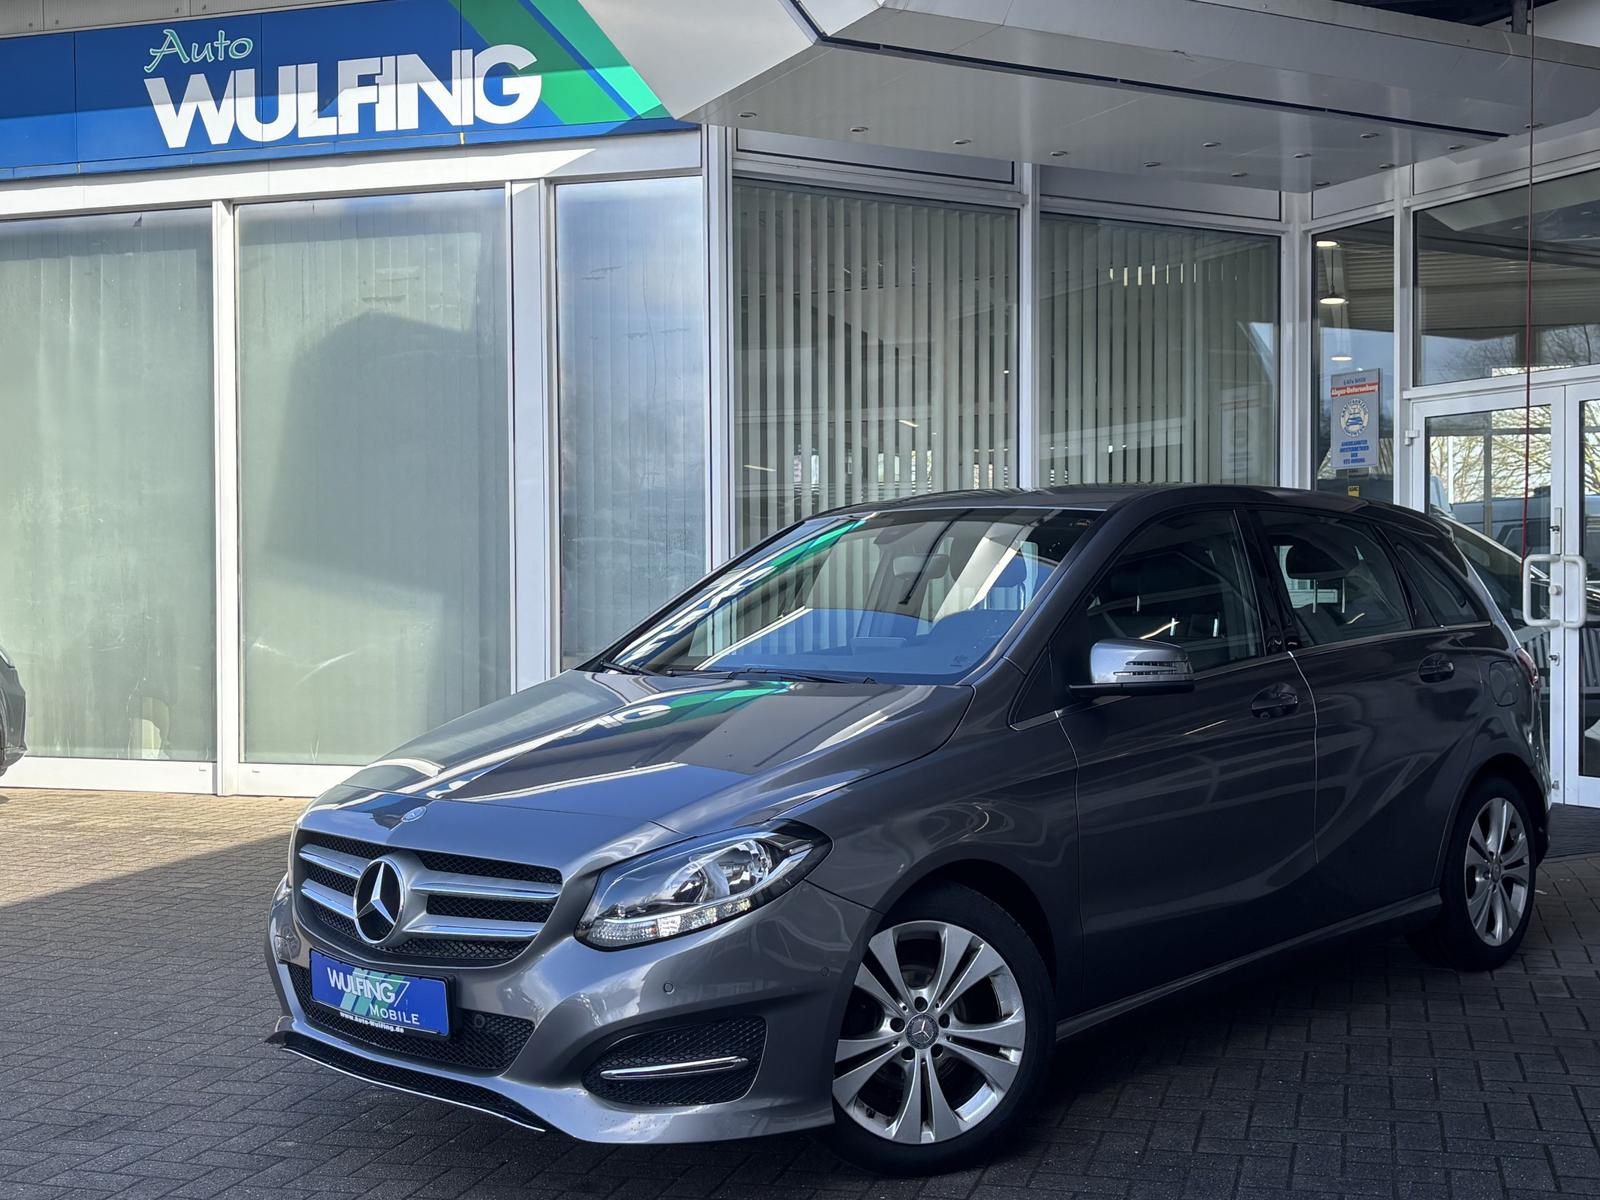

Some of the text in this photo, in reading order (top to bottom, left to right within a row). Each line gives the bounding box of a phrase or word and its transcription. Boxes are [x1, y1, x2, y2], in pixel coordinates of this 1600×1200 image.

[144, 29, 253, 73] Auto
[144, 44, 542, 149] WULFING
[327, 967, 396, 1003] WULFING
[370, 1003, 420, 1025] MOBILE
